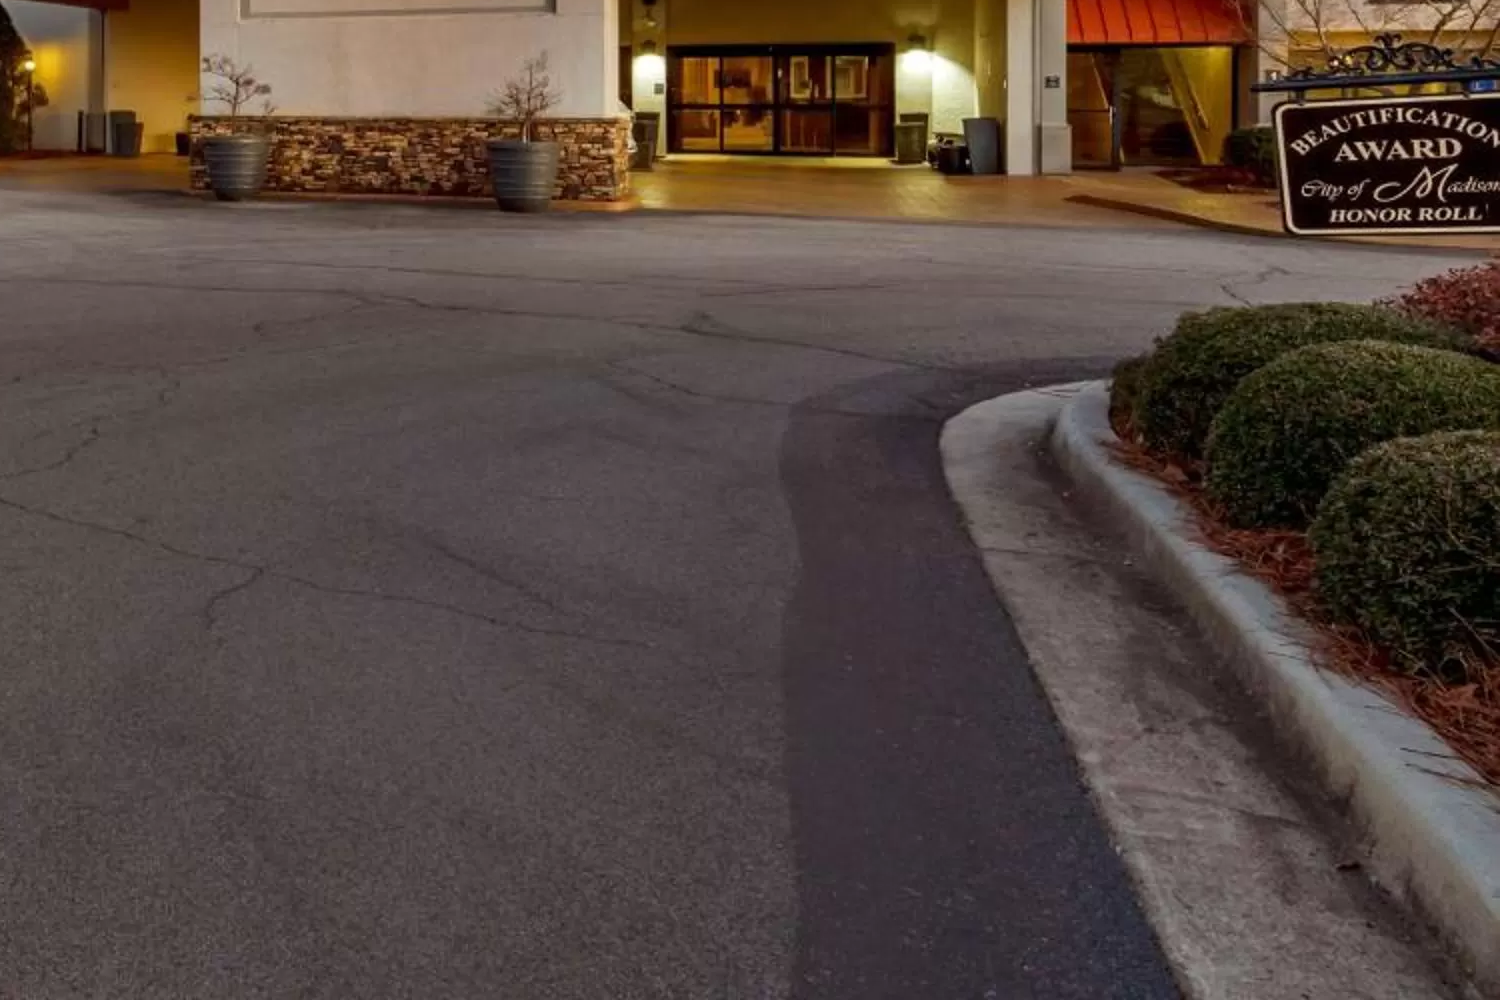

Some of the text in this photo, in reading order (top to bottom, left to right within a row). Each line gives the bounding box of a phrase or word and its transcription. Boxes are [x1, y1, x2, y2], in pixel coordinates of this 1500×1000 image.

[1290, 107, 1500, 156] BEAUTIFICATION
[1334, 137, 1463, 162] AWARD
[1301, 179, 1344, 201] City
[1347, 178, 1372, 201] of
[1329, 206, 1484, 223] HONOR ROLL
